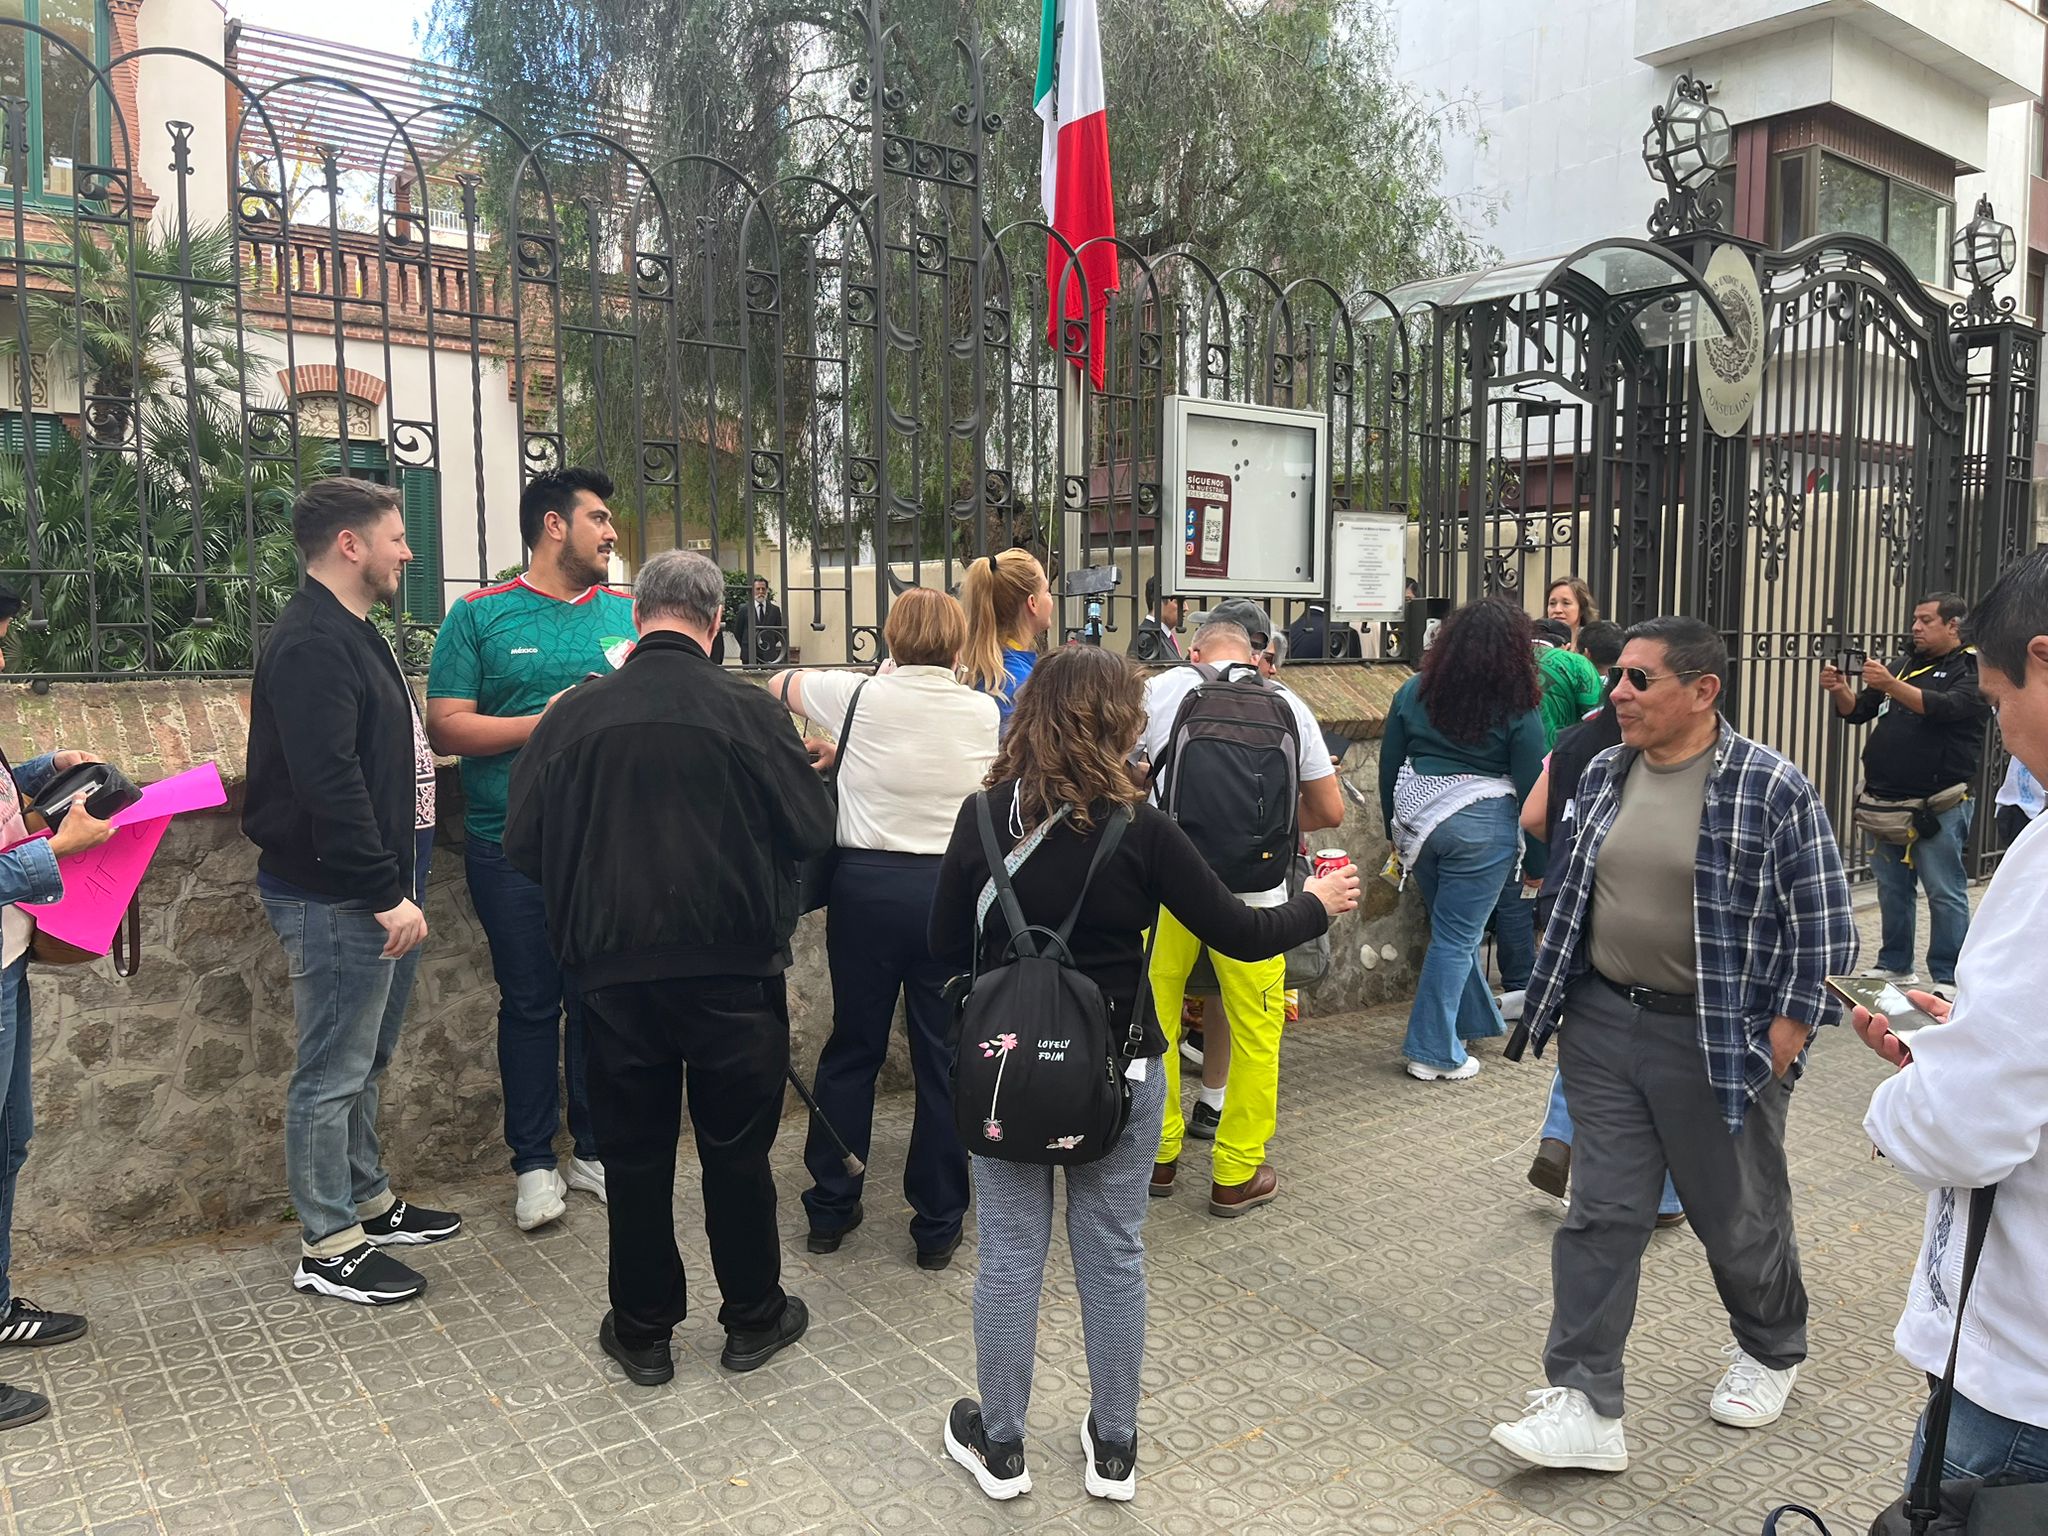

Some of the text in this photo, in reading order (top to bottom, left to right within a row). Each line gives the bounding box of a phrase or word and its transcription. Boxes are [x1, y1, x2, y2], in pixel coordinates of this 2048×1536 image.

[1706, 387, 1750, 416] CONSULADO
[1187, 475, 1225, 488] SÍGUENOS
[1037, 1039, 1071, 1050] LOVELY
